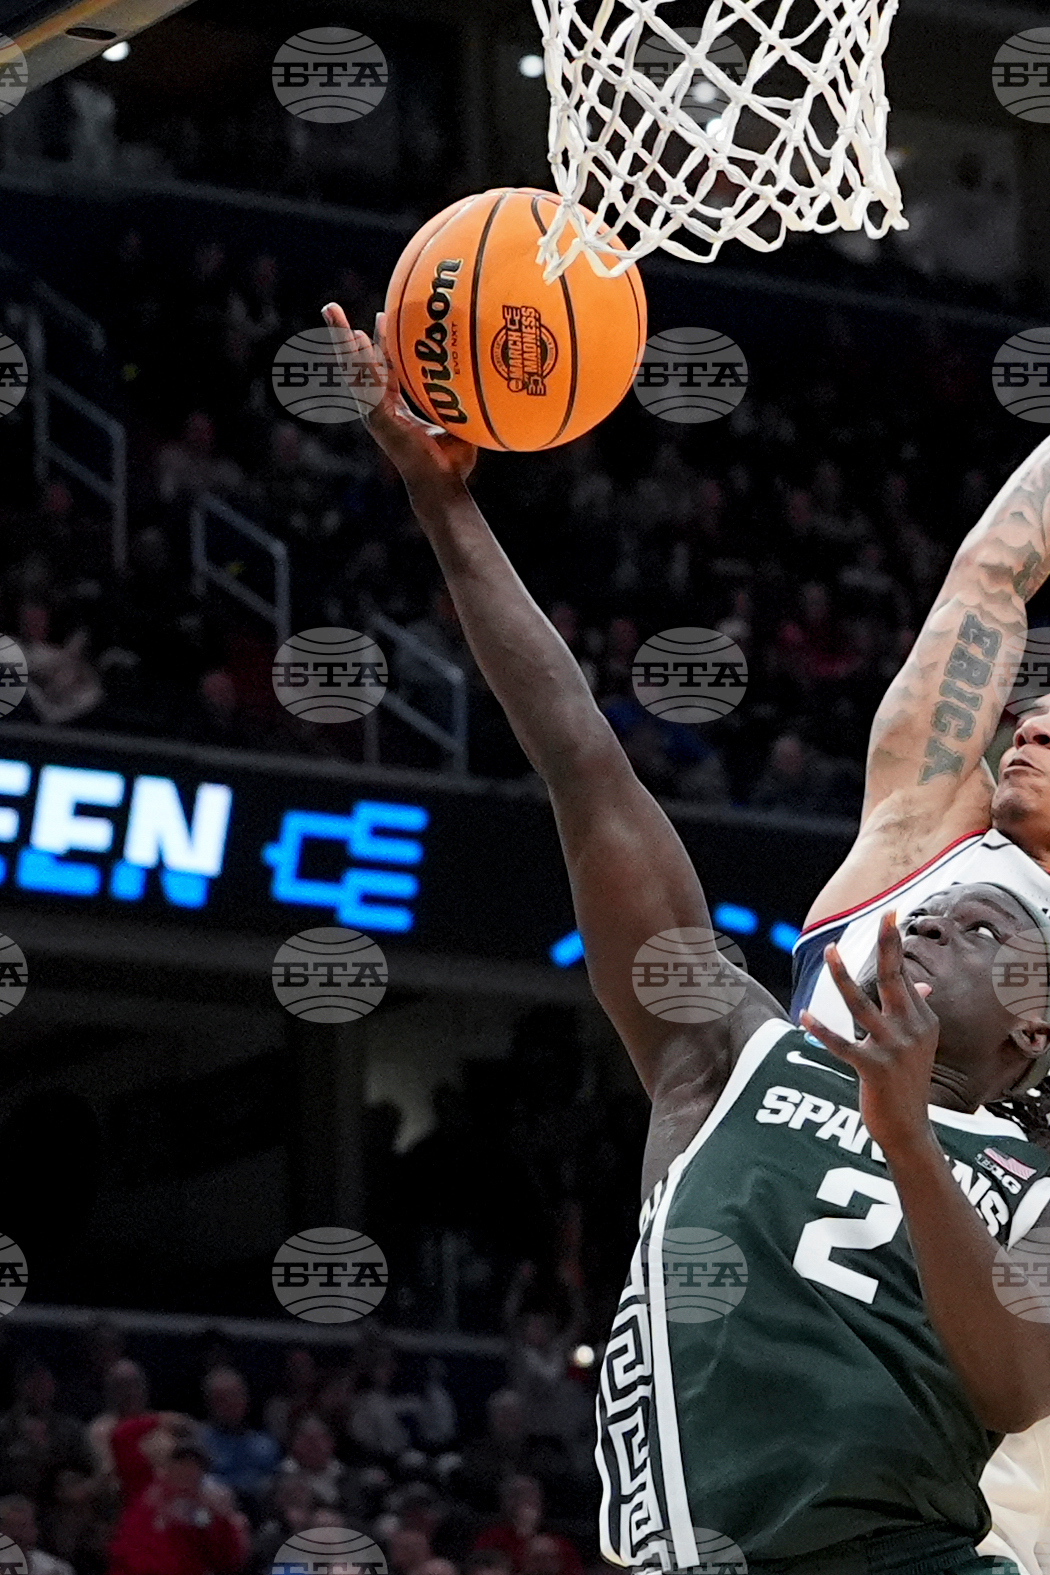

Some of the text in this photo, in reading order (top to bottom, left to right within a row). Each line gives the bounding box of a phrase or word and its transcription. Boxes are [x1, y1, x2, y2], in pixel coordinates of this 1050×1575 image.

[414, 258, 468, 424] Wilson
[508, 330, 523, 379] MARCH
[521, 307, 539, 373] MADNESS
[792, 1167, 903, 1305] 2
